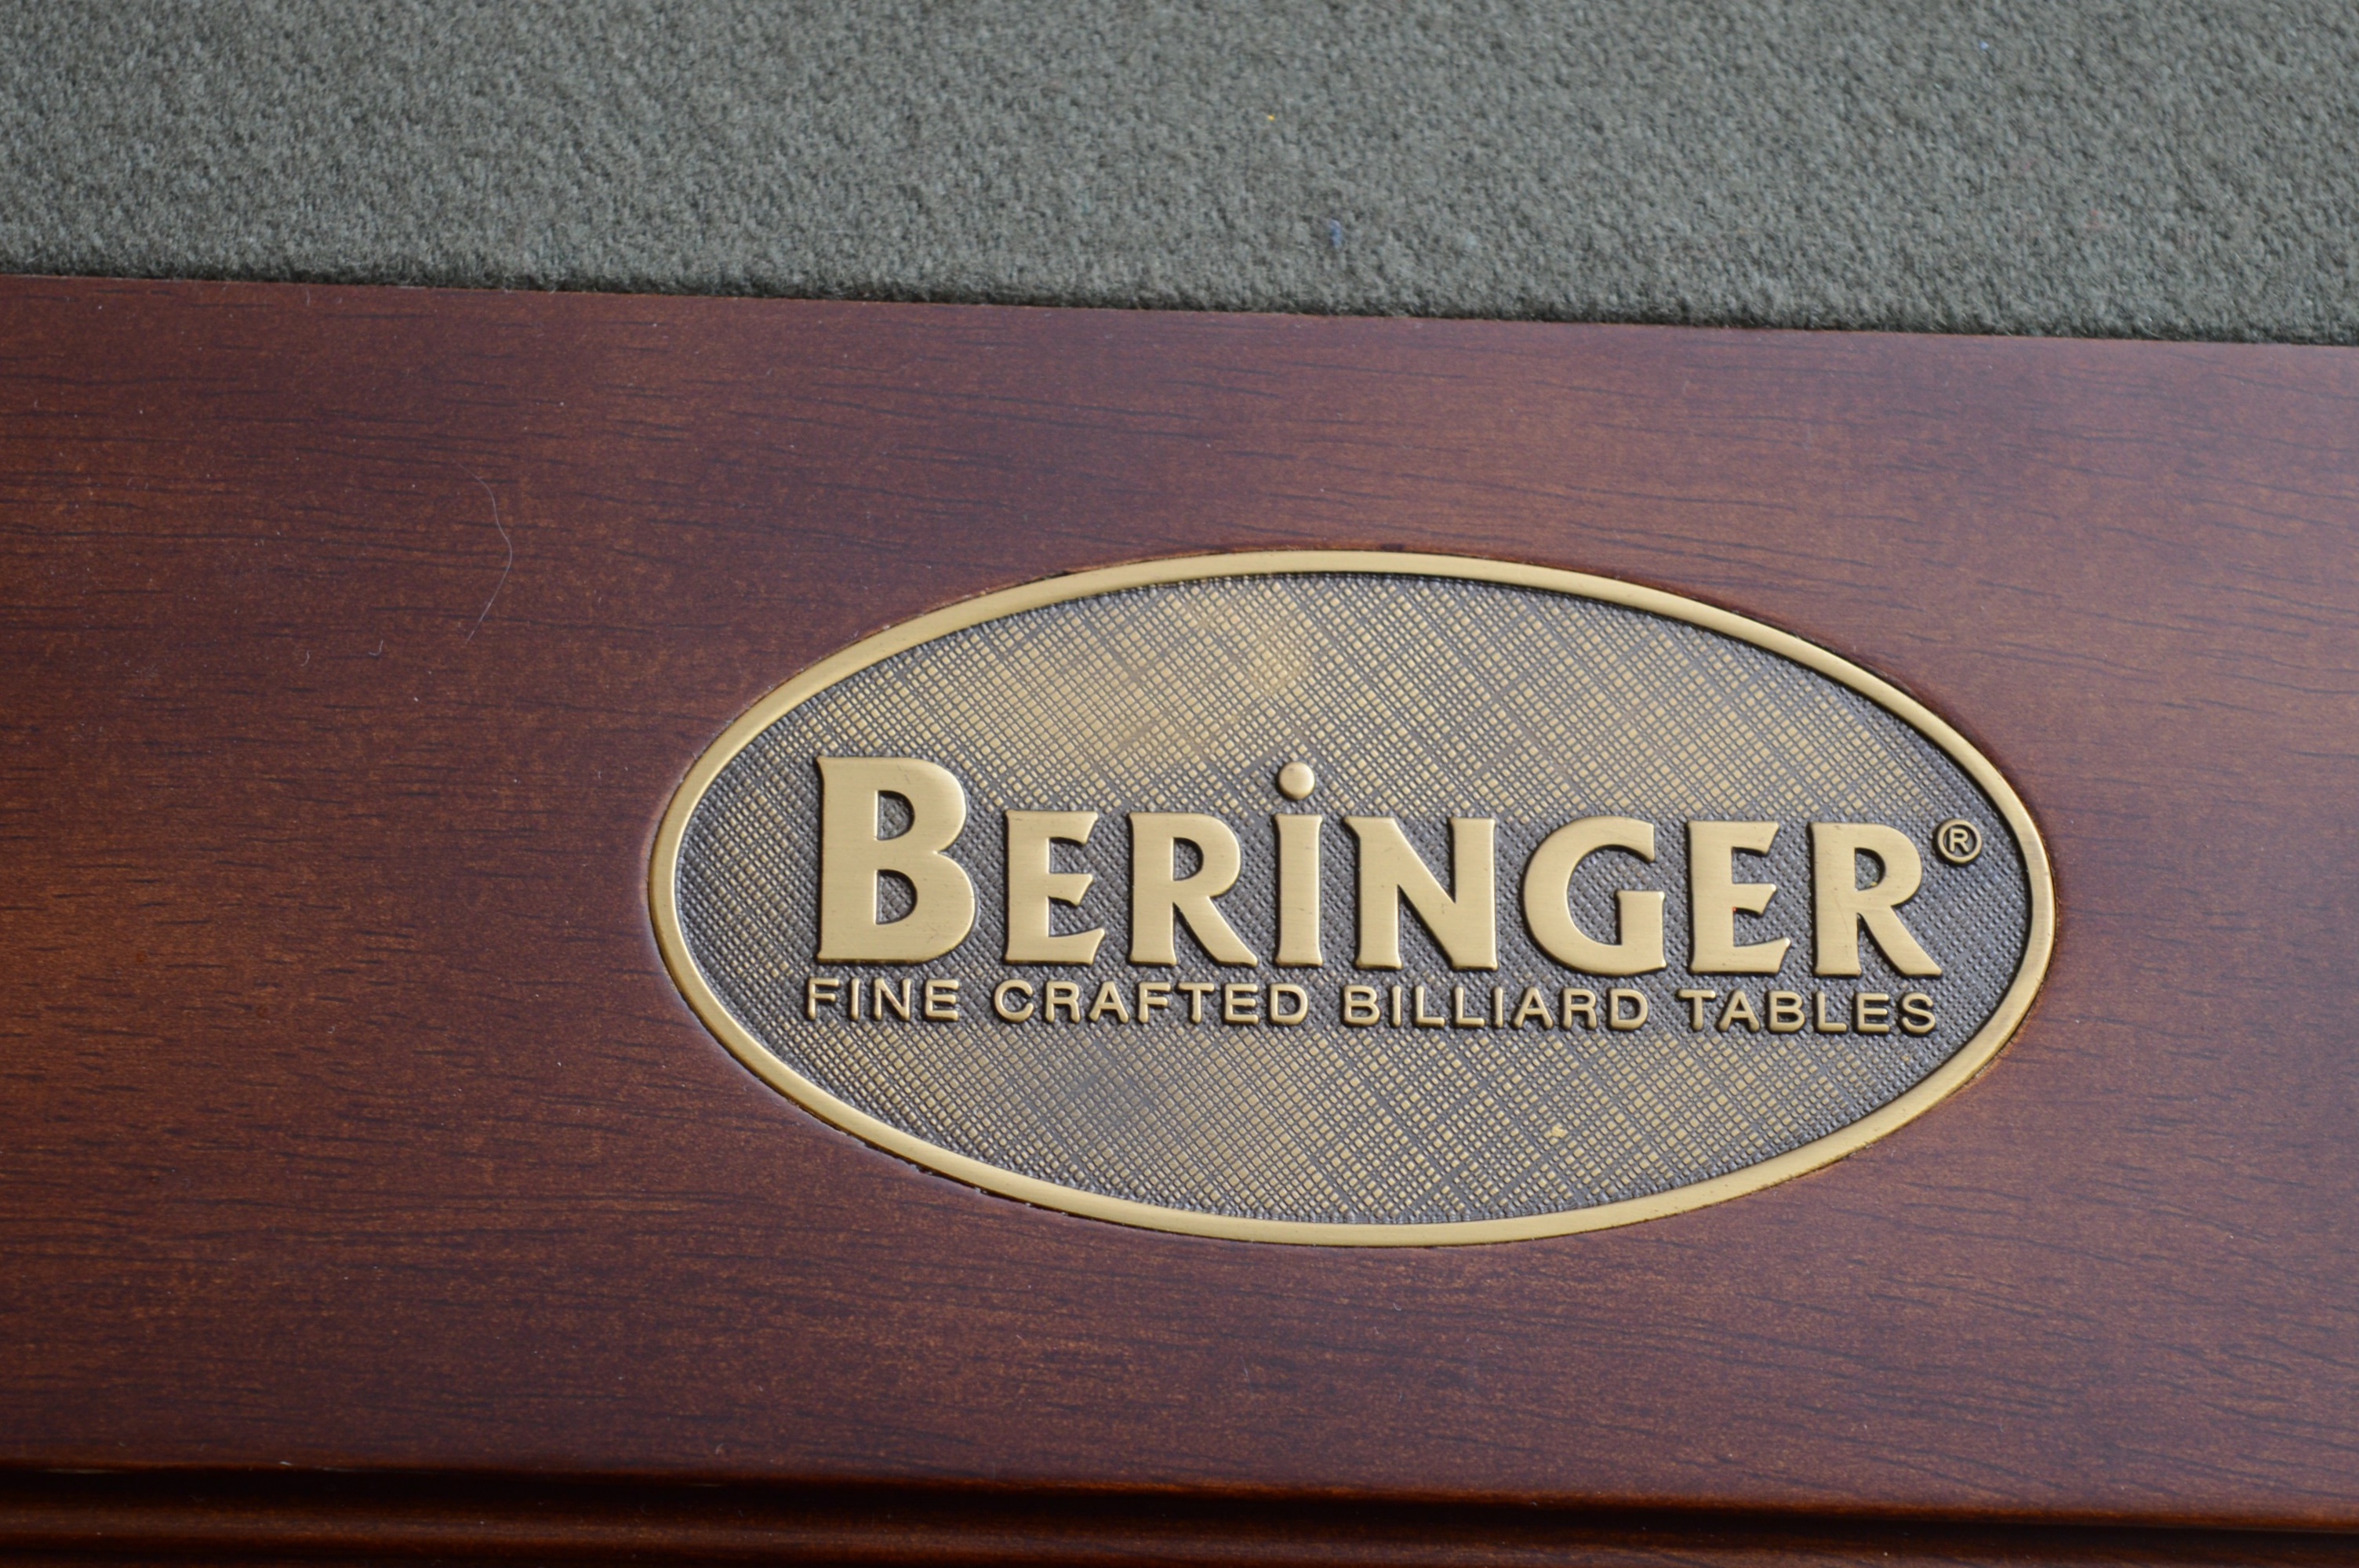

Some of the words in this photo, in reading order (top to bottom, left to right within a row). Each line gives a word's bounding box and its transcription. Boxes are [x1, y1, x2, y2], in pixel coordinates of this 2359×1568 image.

[806, 977, 961, 1022] FINE
[992, 978, 1310, 1025] CRAFTED
[1342, 984, 1650, 1031] BILLIARD
[1677, 986, 1937, 1034] TABLES
